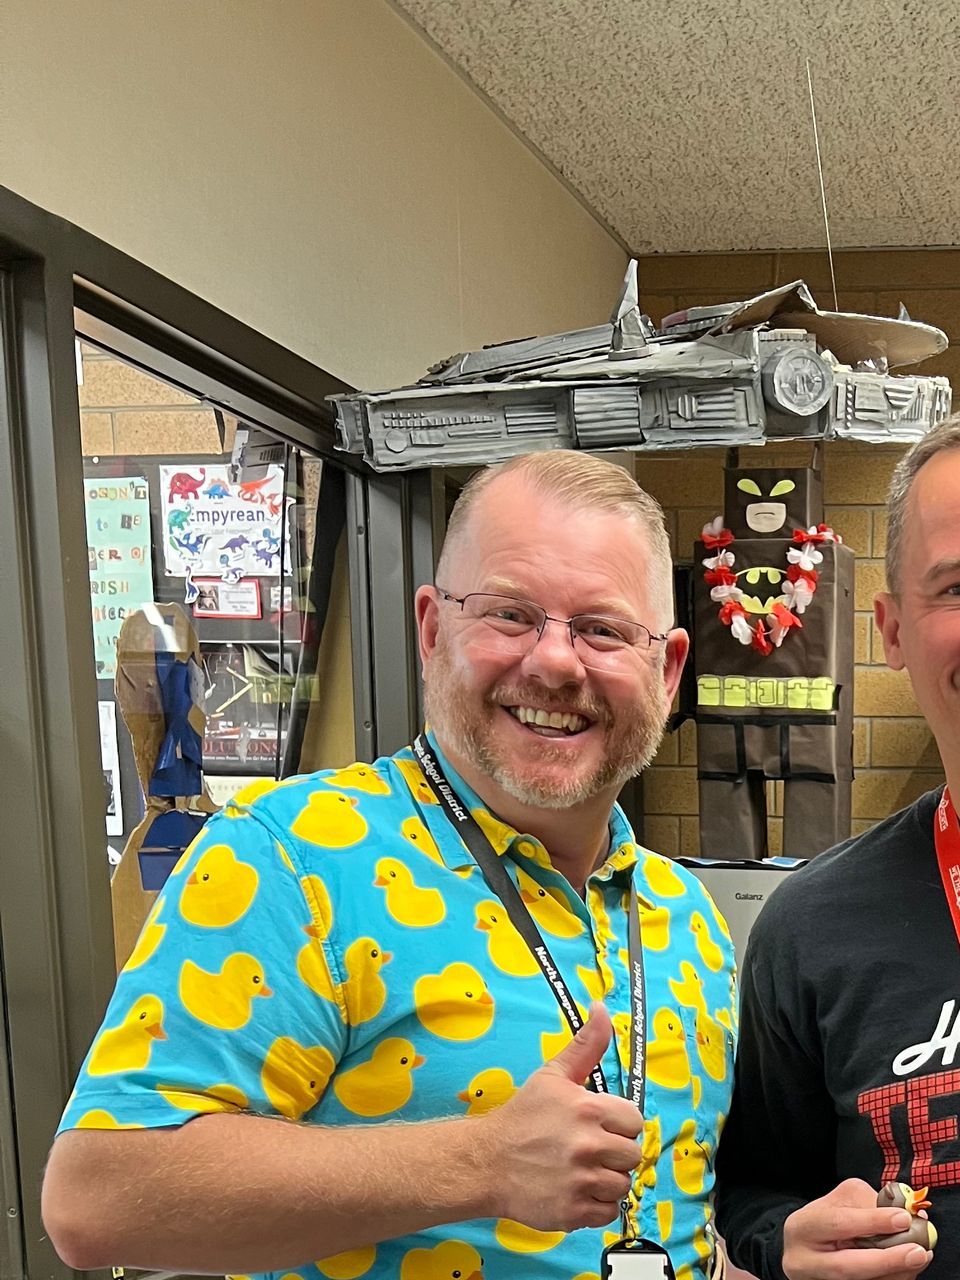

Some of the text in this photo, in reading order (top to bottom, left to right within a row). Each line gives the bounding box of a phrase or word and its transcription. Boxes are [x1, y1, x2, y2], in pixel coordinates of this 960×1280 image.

[438, 784, 467, 821] District
[735, 892, 764, 901] Galanz
[535, 945, 580, 1029] North Sanpete
[633, 961, 643, 1001] District
[634, 1002, 645, 1035] School
[632, 1035, 645, 1078] Sanpete
